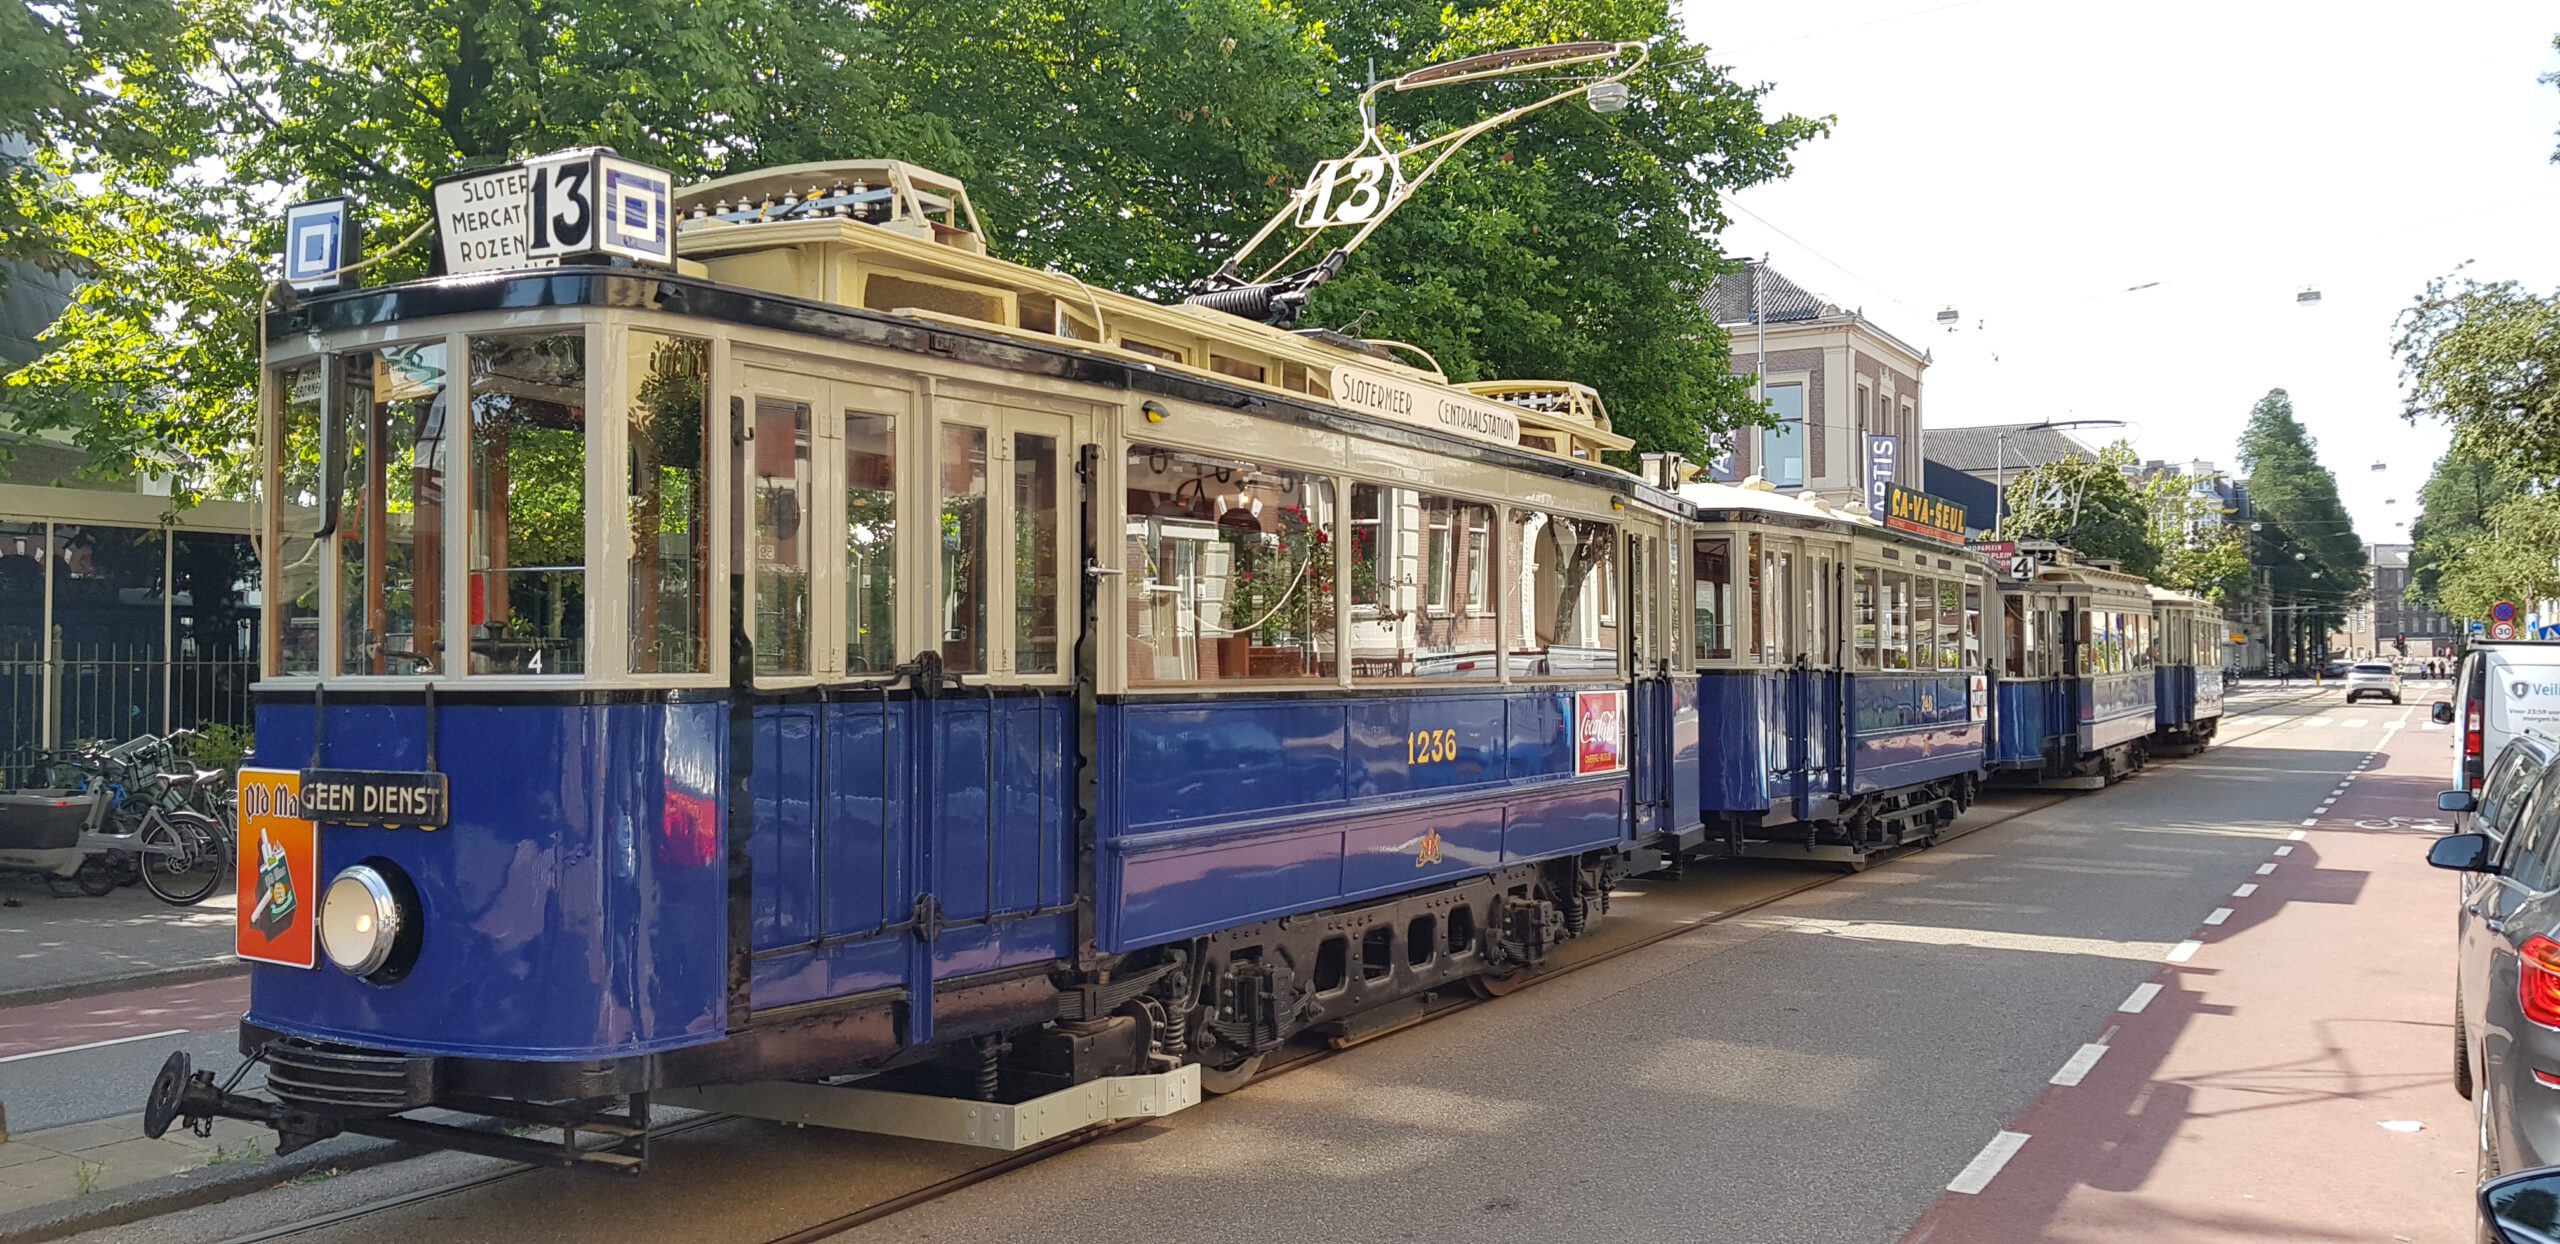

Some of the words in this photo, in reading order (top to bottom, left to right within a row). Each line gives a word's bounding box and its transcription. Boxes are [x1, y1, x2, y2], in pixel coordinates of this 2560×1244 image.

[530, 160, 591, 250] 13
[1304, 159, 1384, 225] 13
[452, 204, 528, 235] MERCAT
[460, 233, 526, 262] ROZEN
[1342, 373, 1413, 417] SLOTERMEER
[1438, 399, 1514, 442] CENTRAALSTATION
[1667, 455, 1680, 491] 13
[1891, 488, 1965, 534] CA-VA-SEUL
[2042, 482, 2067, 509] 4
[2013, 557, 2033, 577] 4
[2497, 627, 2511, 636] 30
[528, 648, 543, 674] 4
[1407, 728, 1457, 765] 1236
[245, 782, 270, 824] Old
[273, 782, 299, 818] Ma
[300, 782, 355, 812] GEEN
[363, 785, 440, 816] DIENST
